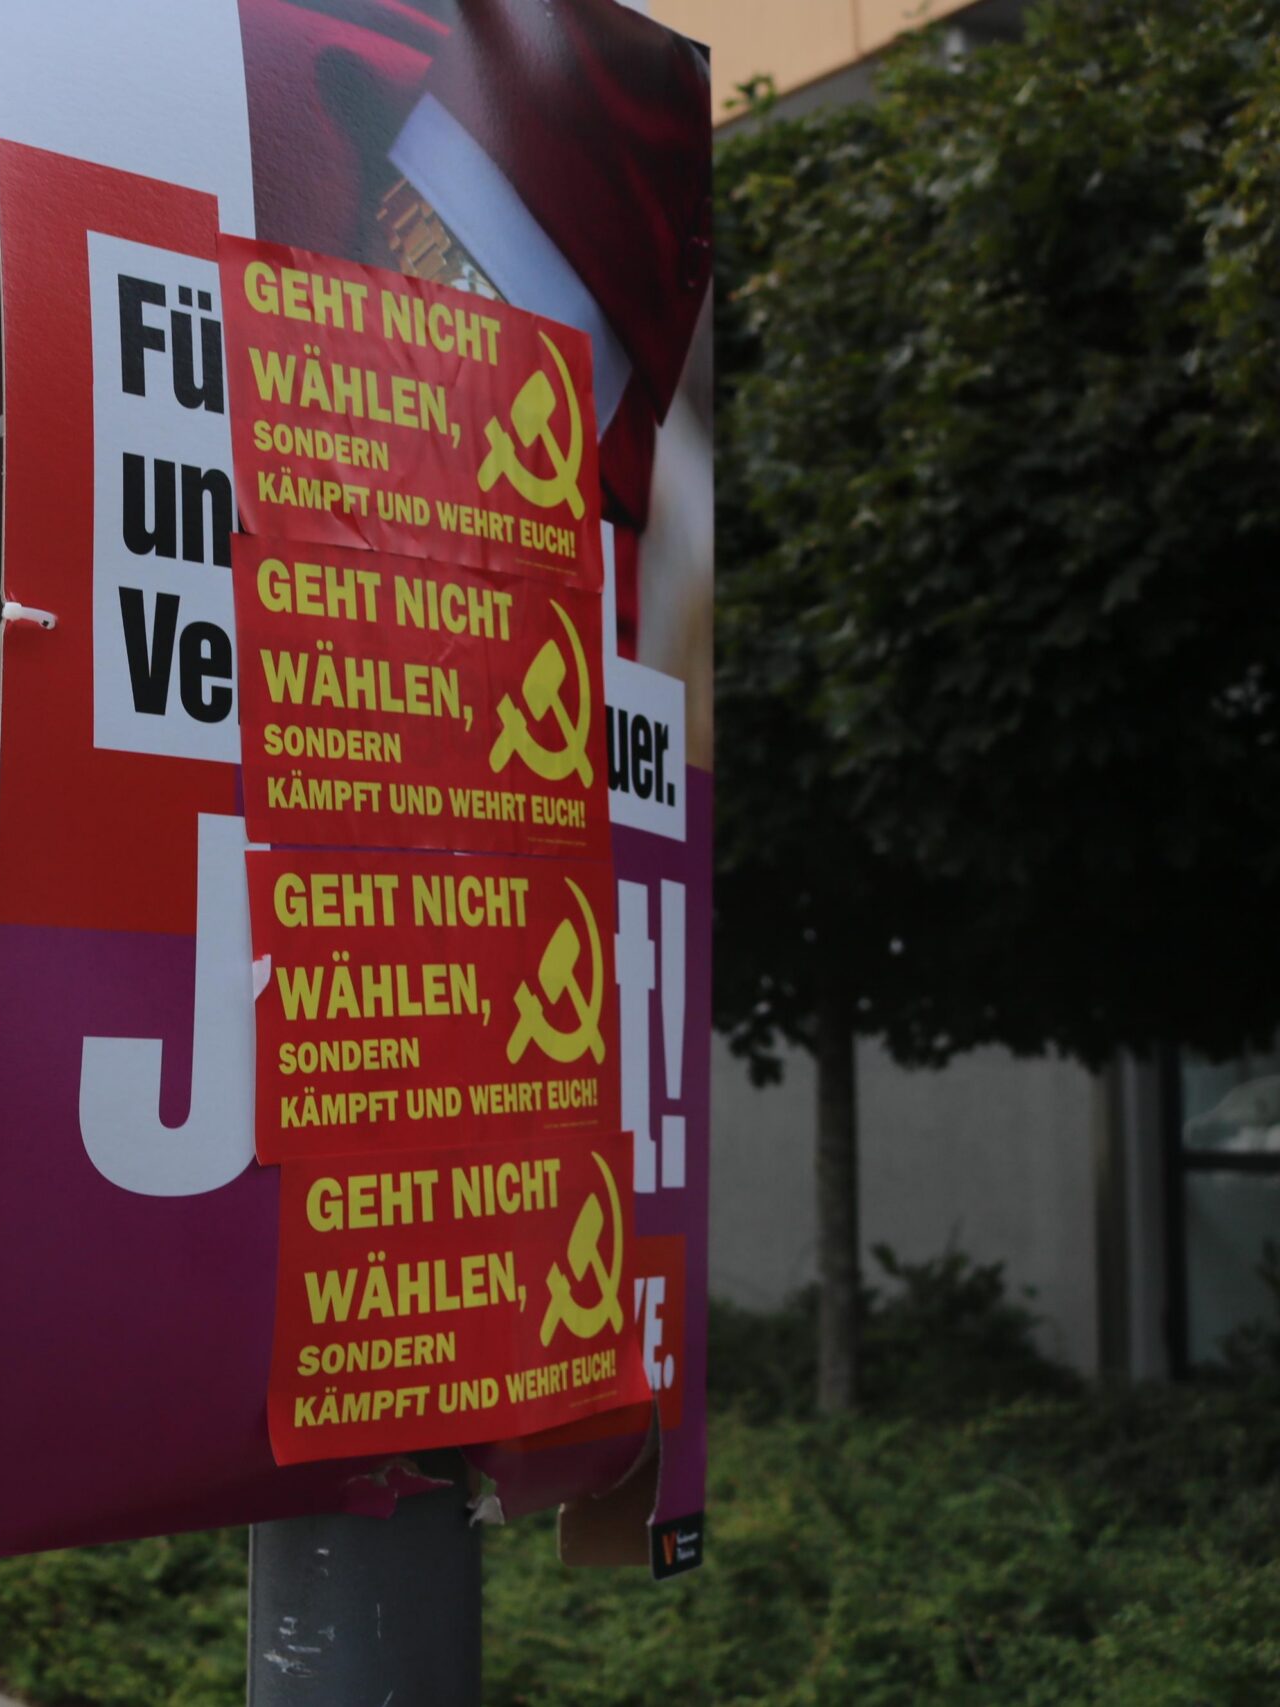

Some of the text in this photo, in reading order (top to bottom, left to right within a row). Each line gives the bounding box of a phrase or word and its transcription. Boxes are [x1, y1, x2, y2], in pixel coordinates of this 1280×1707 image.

[118, 274, 224, 415] Fü
[244, 261, 501, 365] GEHT NICHT
[249, 345, 461, 446] WÄHLEN,
[253, 420, 390, 471] SONDERN
[122, 452, 246, 569] un
[258, 470, 577, 559] KÄMPFT UND WEHRT EUCH!
[257, 559, 513, 641] GEHT NICHT
[118, 586, 240, 726] Ve
[260, 640, 474, 731] WÄHLEN,
[264, 723, 402, 763] SONDERN
[606, 704, 676, 807] uer.
[267, 777, 586, 829] KÄMPFT UND WEHRT EUCH!
[273, 873, 529, 928] GEHT NICHT
[79, 812, 686, 1197] J t!
[276, 951, 491, 1026] WÄHLEN,
[279, 1038, 420, 1075] SONDERN
[281, 1077, 598, 1128] KÄMPFT UND WEHRT EUCH!
[306, 1160, 561, 1233] GEHT NICHT
[305, 1252, 527, 1324] WÄHLEN,
[294, 1385, 431, 1427] KÄMPFT
[439, 1378, 500, 1414] UND
[507, 1361, 569, 1404] WEHRT
[572, 1349, 616, 1387] EUCH!
[298, 1332, 456, 1376] SONDERN
